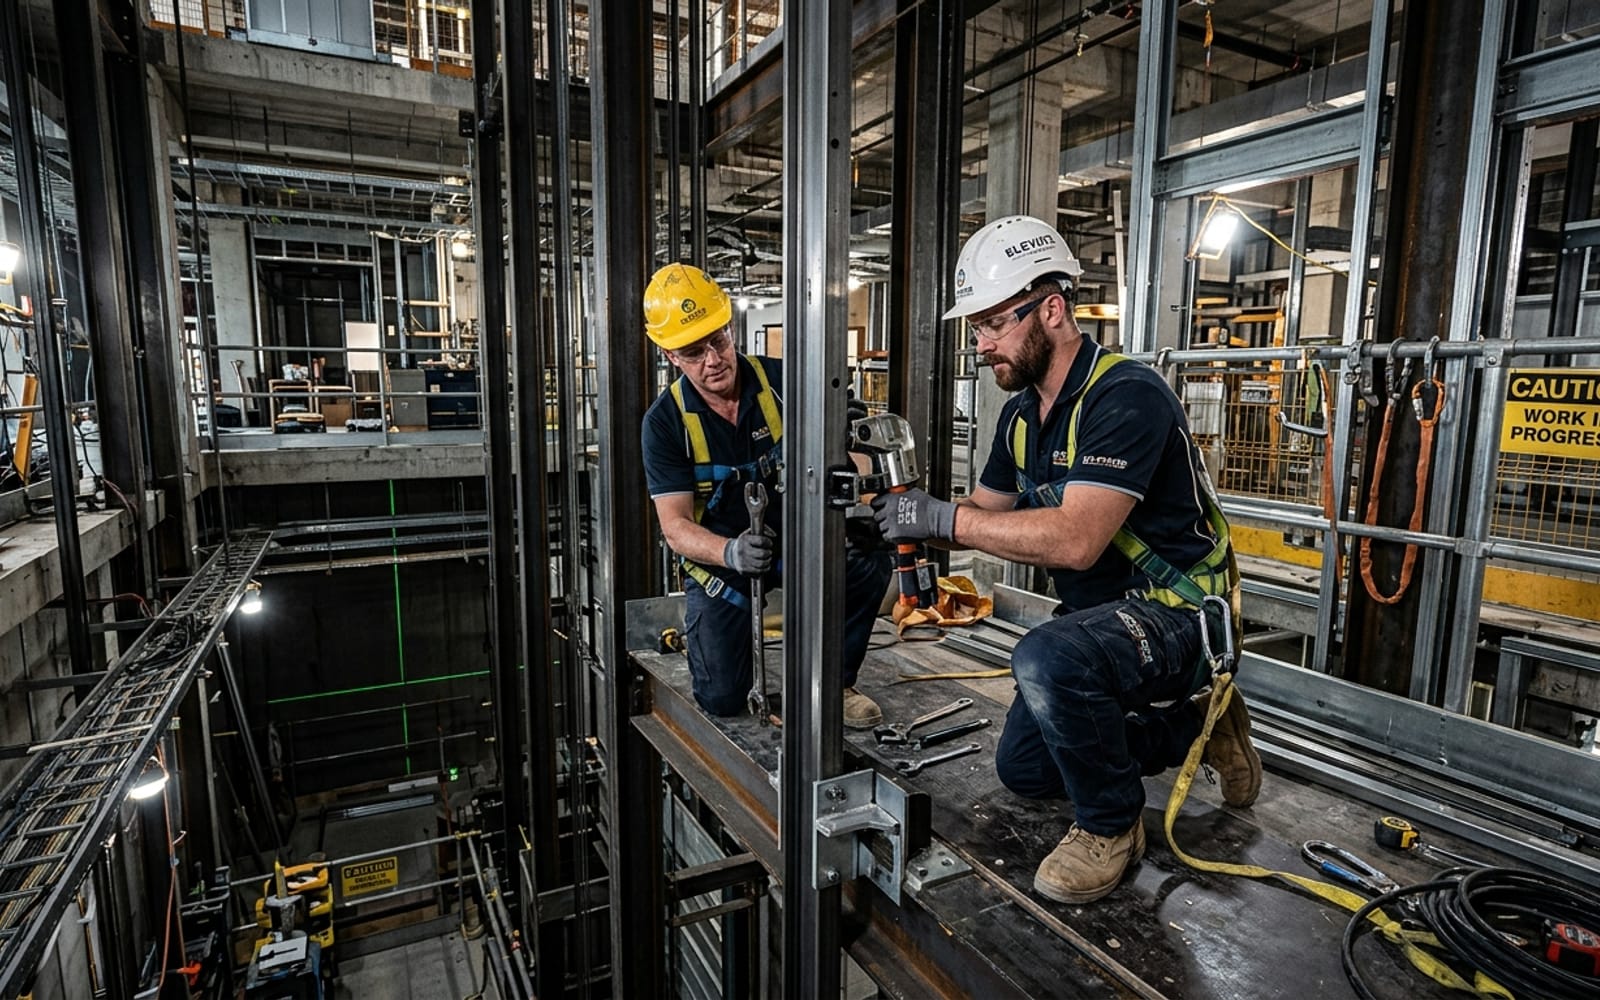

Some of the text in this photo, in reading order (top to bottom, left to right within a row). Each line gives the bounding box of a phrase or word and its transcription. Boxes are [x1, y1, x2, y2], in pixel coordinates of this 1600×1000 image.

[1511, 378, 1600, 399] CAUTI
[1524, 408, 1600, 426] WORK I
